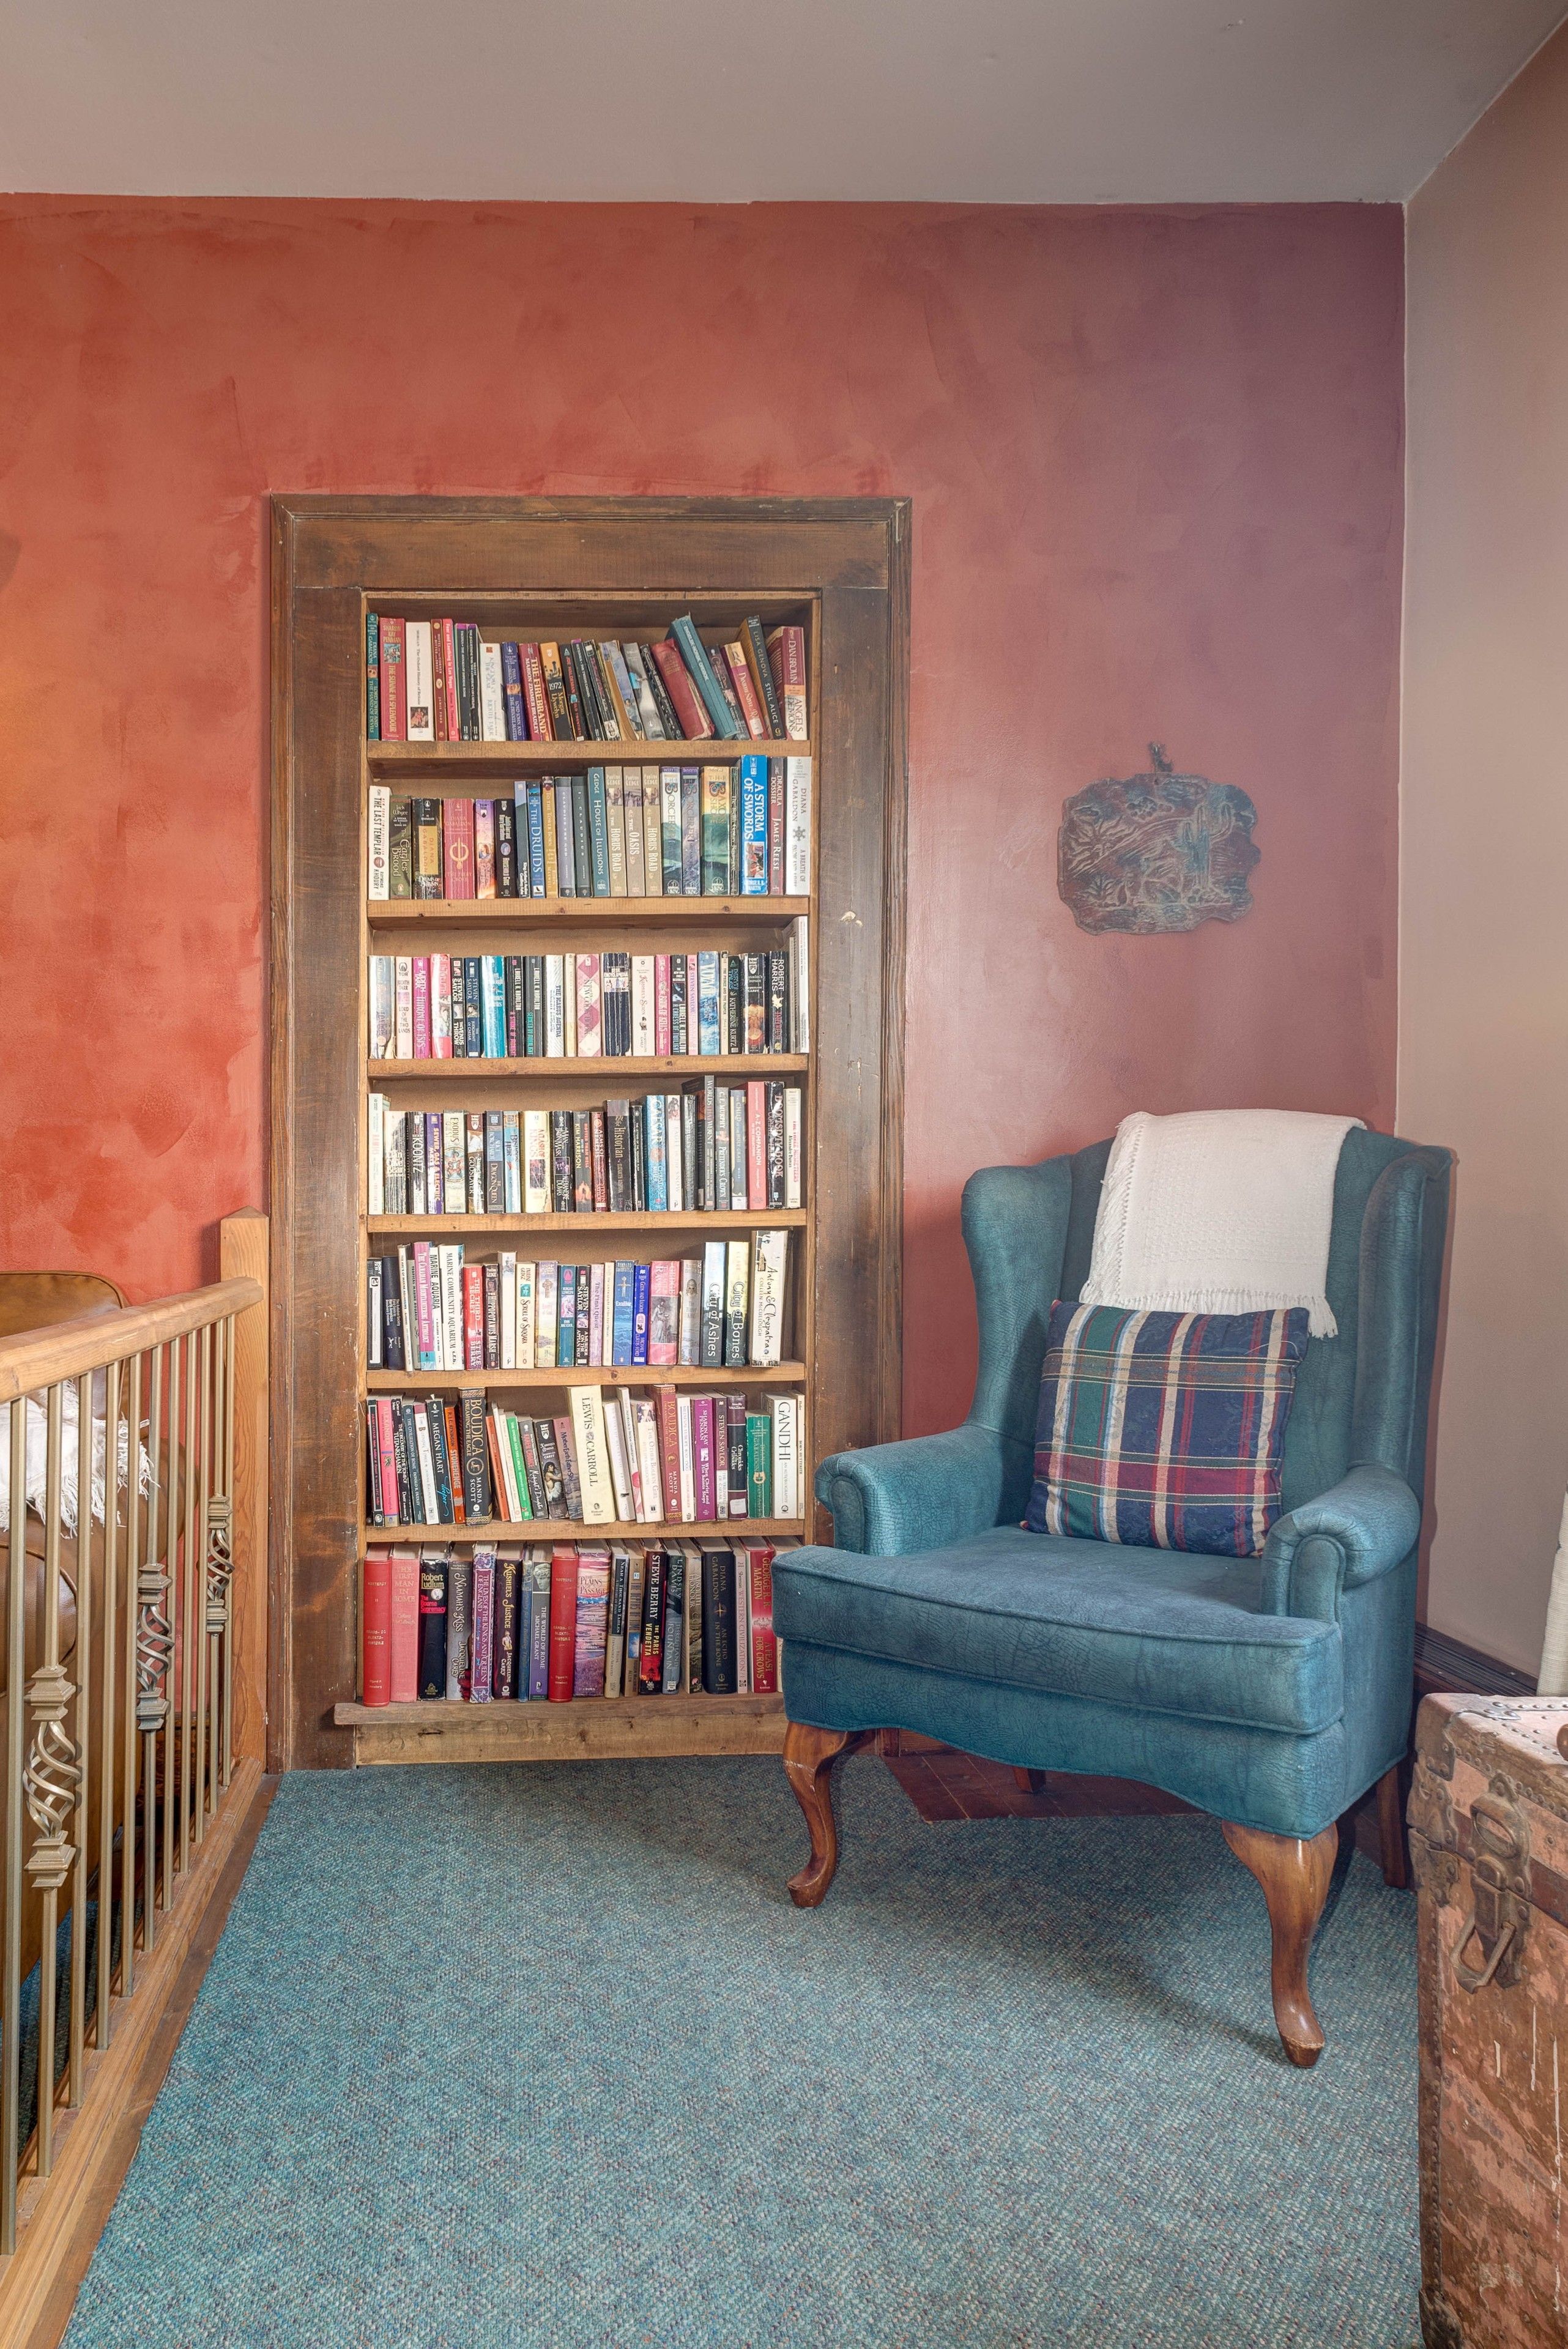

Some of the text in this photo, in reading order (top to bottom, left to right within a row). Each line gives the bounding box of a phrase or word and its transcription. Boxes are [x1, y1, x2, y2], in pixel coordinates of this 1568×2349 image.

[788, 640, 798, 683] DAN BROWN
[757, 649, 768, 678] GENOVA
[770, 703, 778, 724] ALICE
[533, 679, 546, 733] FIREBRAND
[743, 778, 753, 840] OF SWORDS
[754, 794, 765, 831] STORM
[611, 828, 621, 852] HORUS
[630, 832, 639, 855] OASIS
[648, 828, 658, 851] HORUS
[772, 818, 781, 842] JAMES
[532, 827, 542, 872] DRUIDS
[612, 853, 622, 872] ROAD
[648, 853, 658, 871] ROAD
[412, 1138, 423, 1173] KOONTZ
[614, 1127, 626, 1158] Historian
[429, 1255, 440, 1309] MARINE AQUARIA
[765, 1266, 778, 1295] Antony
[708, 1310, 719, 1320] of
[764, 1304, 776, 1348] Cleopatra
[488, 1335, 497, 1353] MARSH
[708, 1322, 719, 1356] Ashes
[732, 1323, 743, 1358] Bones
[432, 1423, 441, 1450] MEGAN
[470, 1398, 484, 1456] BOUDICA
[582, 1397, 598, 1486] LEWIS CARROLL
[667, 1401, 677, 1447] BOUDICA
[778, 1402, 790, 1460] GANDHI
[393, 1431, 402, 1474] TUTANKHAMEN
[450, 1450, 461, 1489] STONEHENGE
[437, 1484, 450, 1505] deeper
[649, 1555, 660, 1619] STEVE BERRY
[753, 1567, 762, 1600] MARTIN
[453, 1612, 465, 1632] KISS
[540, 1642, 546, 1651] OF
